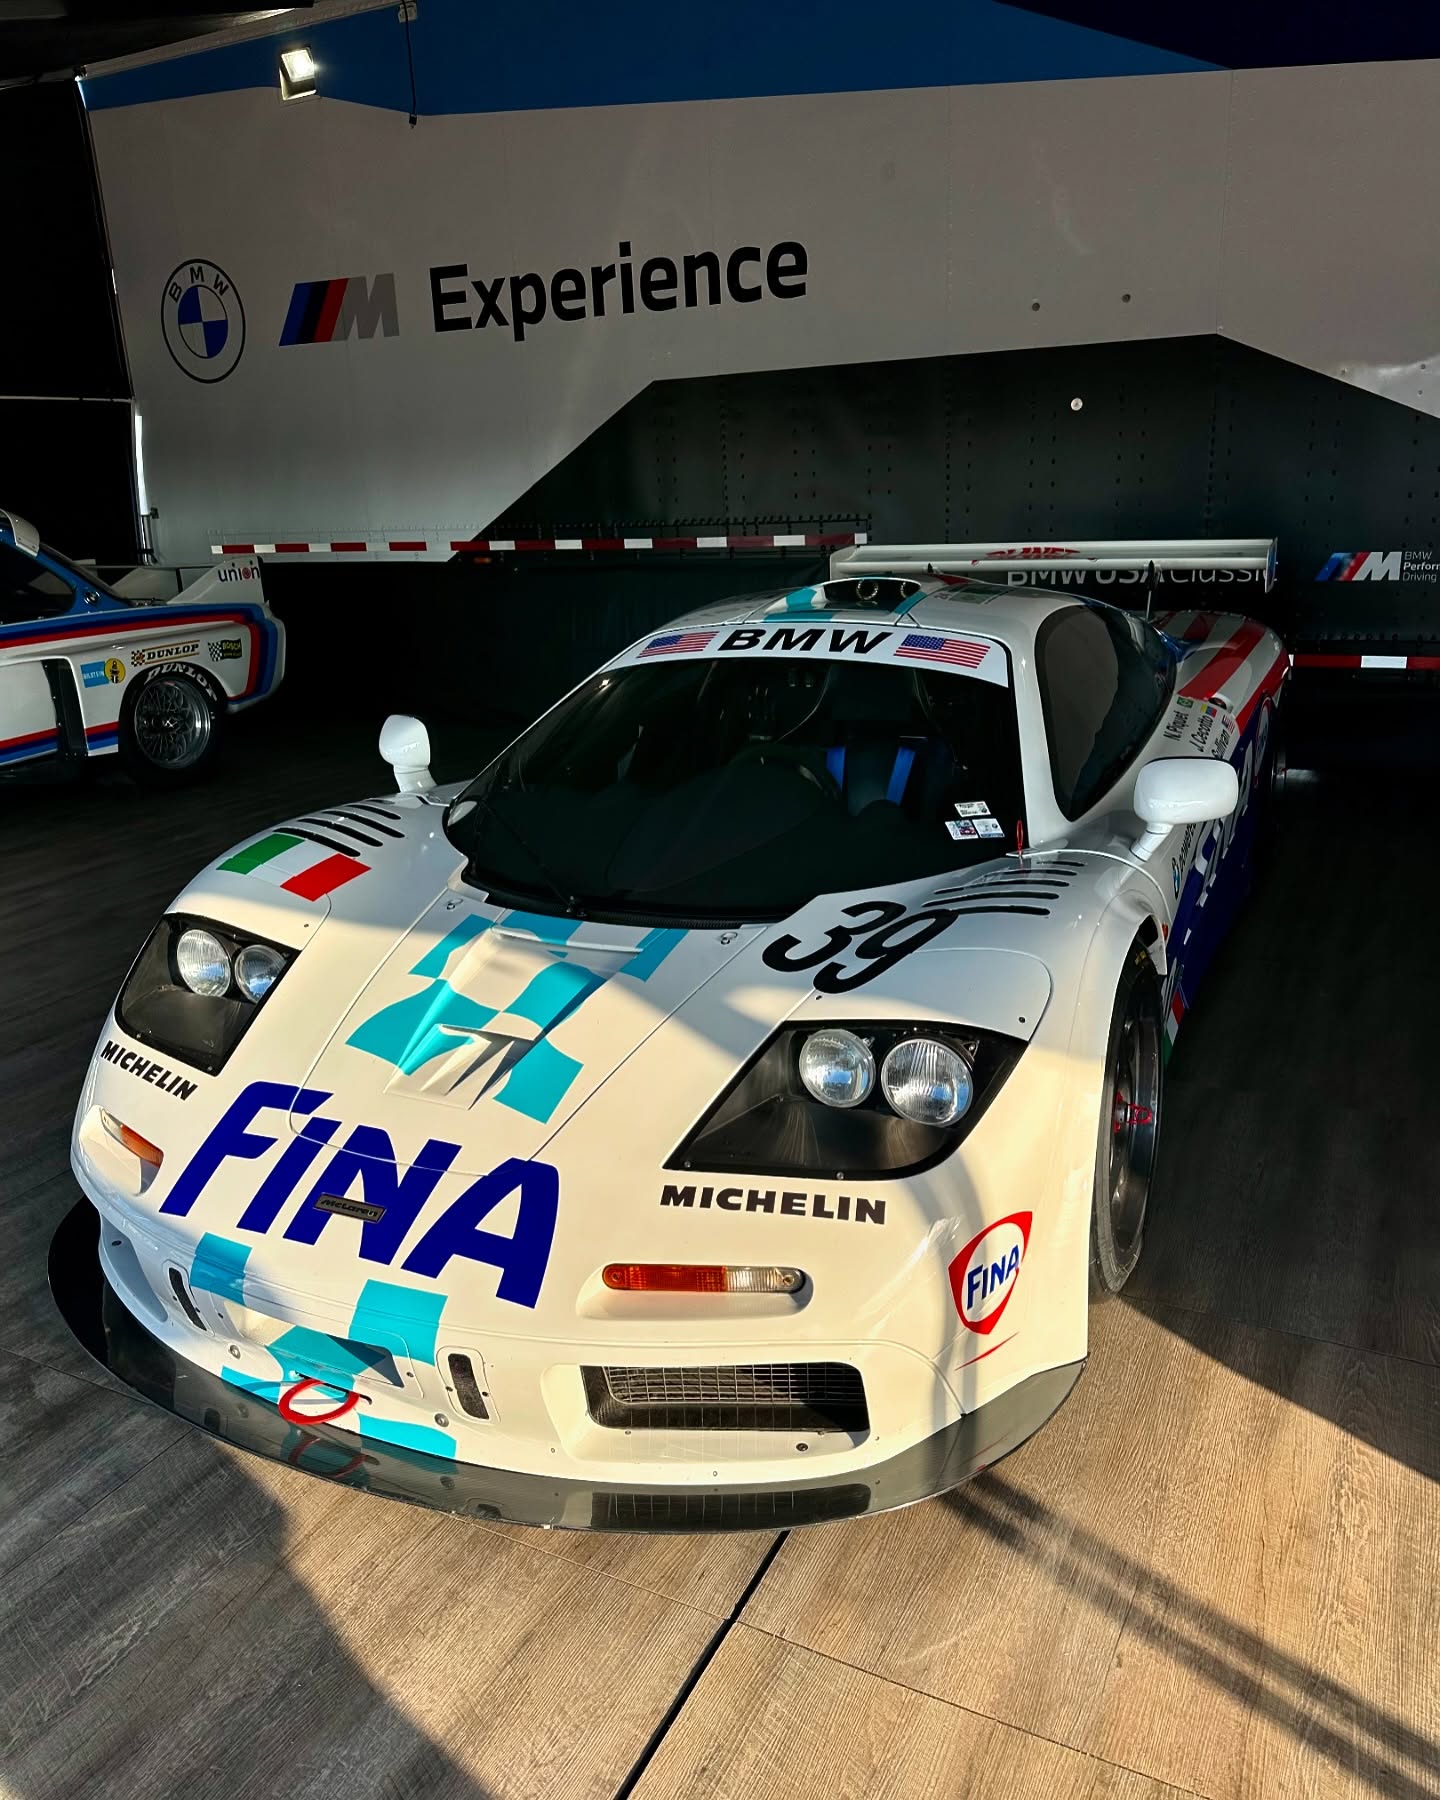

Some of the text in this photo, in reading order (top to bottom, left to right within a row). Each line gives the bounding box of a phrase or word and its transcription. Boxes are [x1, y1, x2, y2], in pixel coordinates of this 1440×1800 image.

[169, 266, 229, 303] BMW
[429, 240, 809, 341] Experience
[1404, 551, 1432, 561] BMW
[217, 566, 260, 582] union
[1170, 569, 1278, 584] Classi
[1402, 566, 1437, 583] Driving
[147, 643, 199, 660] DUNLOP
[717, 628, 893, 654] BMW
[762, 901, 960, 994] 39
[100, 1041, 198, 1101] MICHELIN
[159, 1081, 559, 1309] FINA
[320, 1199, 379, 1217] McLaren
[660, 1185, 886, 1225] MICHELIN
[967, 1245, 1020, 1310] FINA
